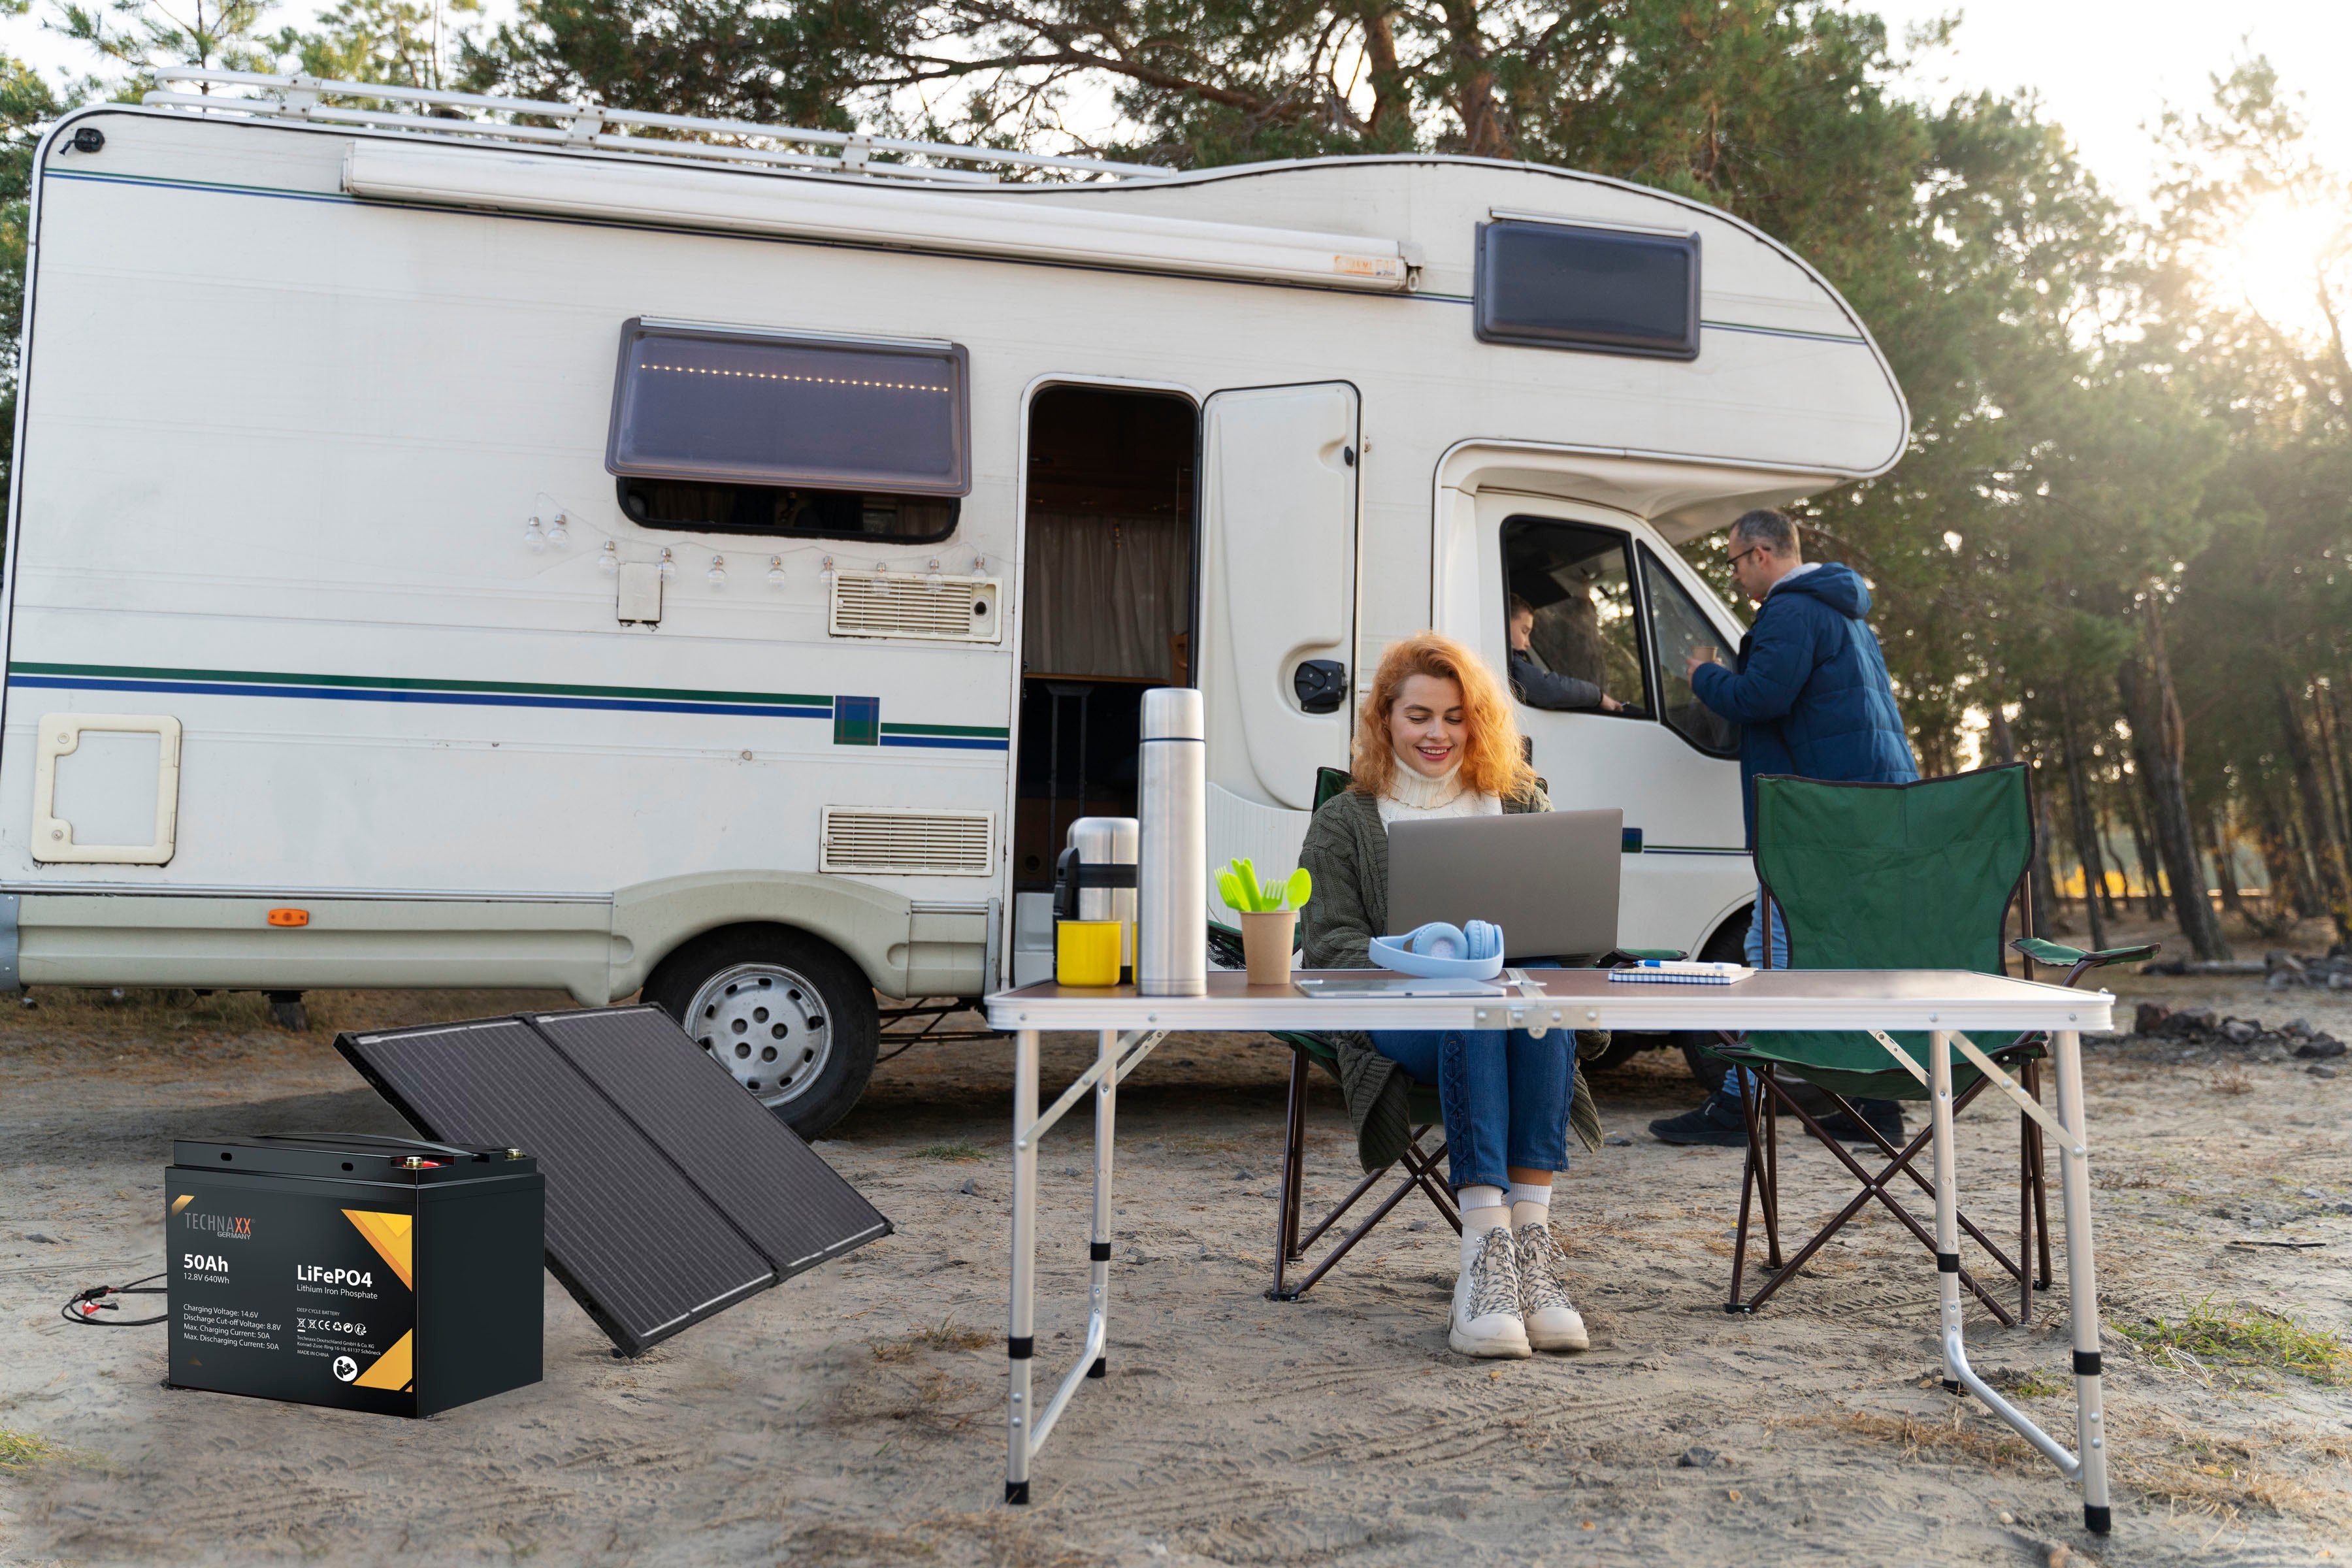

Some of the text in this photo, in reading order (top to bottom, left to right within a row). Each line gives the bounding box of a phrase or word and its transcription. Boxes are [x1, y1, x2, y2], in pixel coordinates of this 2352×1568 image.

[217, 1231, 252, 1240] GERMANY
[184, 1253, 229, 1272] 50Ah
[184, 1273, 229, 1284] 12.8V 640Wh
[297, 1264, 372, 1288] LiFePO4
[297, 1284, 378, 1299] Lithium Iron Phosphate
[183, 1303, 212, 1315] Charging
[213, 1307, 240, 1317] Voltage:
[184, 1313, 215, 1324] Discharge
[216, 1317, 238, 1326] Cut-off
[239, 1320, 266, 1330] Voltage:
[199, 1325, 229, 1335] Charging
[230, 1328, 256, 1338] Current:
[184, 1332, 199, 1341] Max.
[200, 1334, 238, 1347] Discharging
[238, 1339, 265, 1348] Current:
